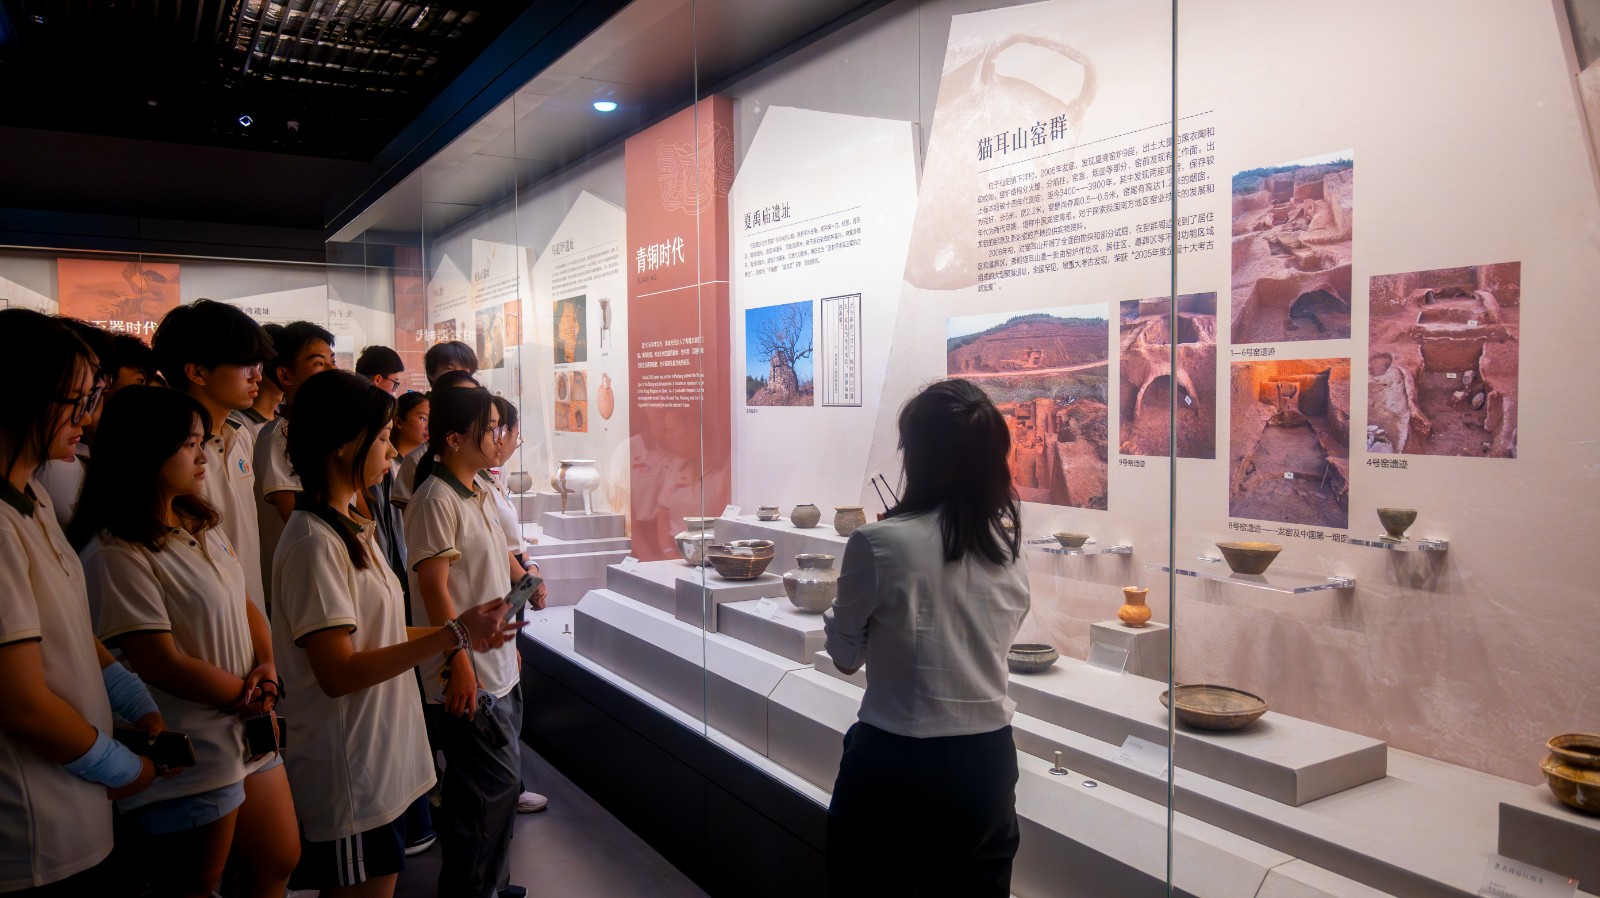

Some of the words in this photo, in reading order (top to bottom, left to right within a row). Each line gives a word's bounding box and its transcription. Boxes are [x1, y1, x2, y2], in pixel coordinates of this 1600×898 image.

[977, 113, 1068, 161] 猫耳山窑群
[744, 201, 791, 231] 夏禹庙遗址
[635, 236, 685, 274] 青铜时代
[1118, 458, 1146, 468] 9号窑遗迹
[1366, 458, 1409, 470] 4号窑遗迹
